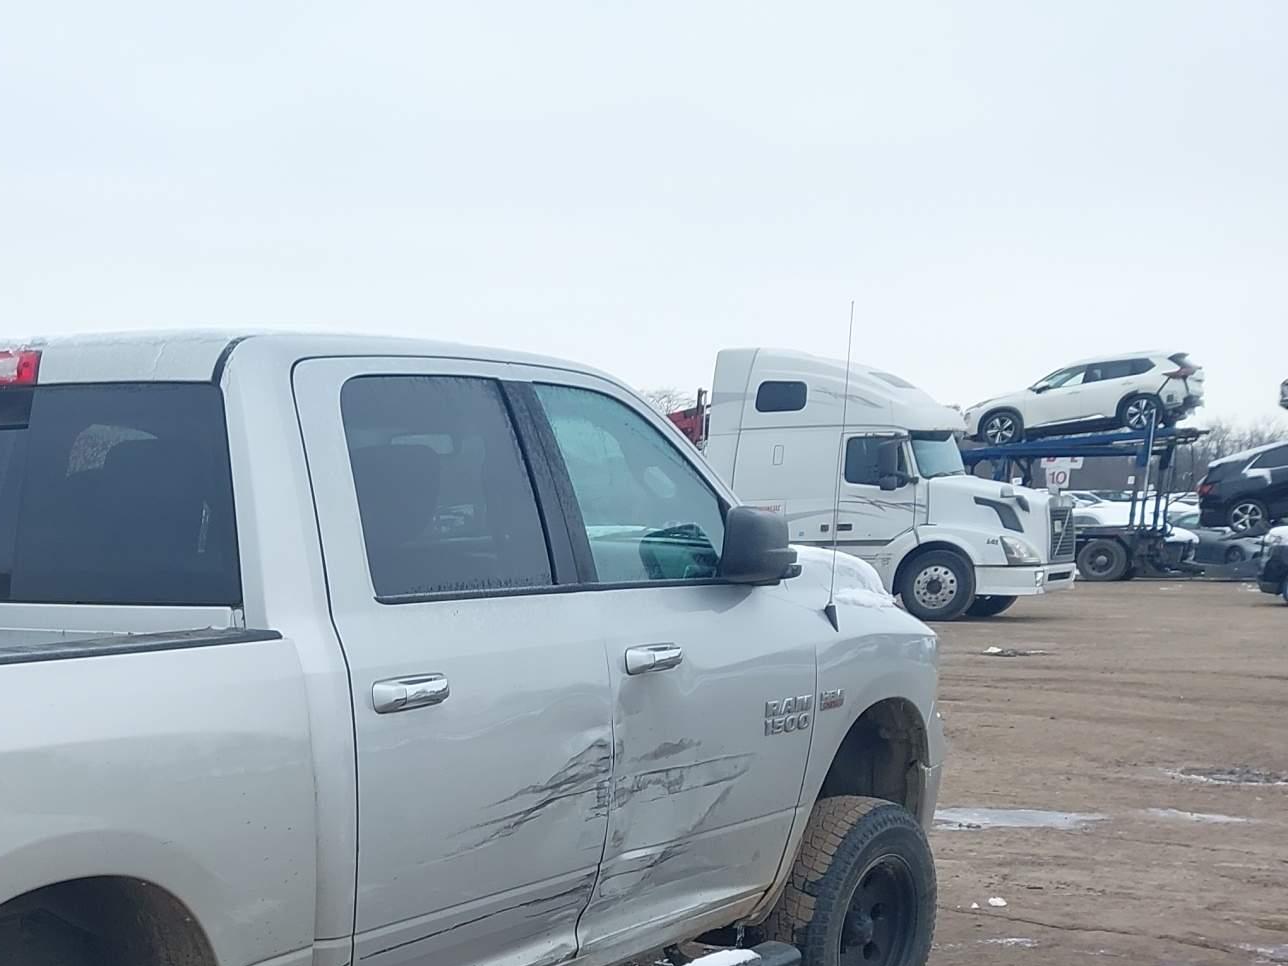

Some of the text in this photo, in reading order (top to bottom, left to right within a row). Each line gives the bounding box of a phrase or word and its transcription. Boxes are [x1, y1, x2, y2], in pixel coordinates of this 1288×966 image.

[1048, 471, 1067, 485] 10
[765, 694, 813, 718] RAM
[764, 712, 810, 736] 1500
